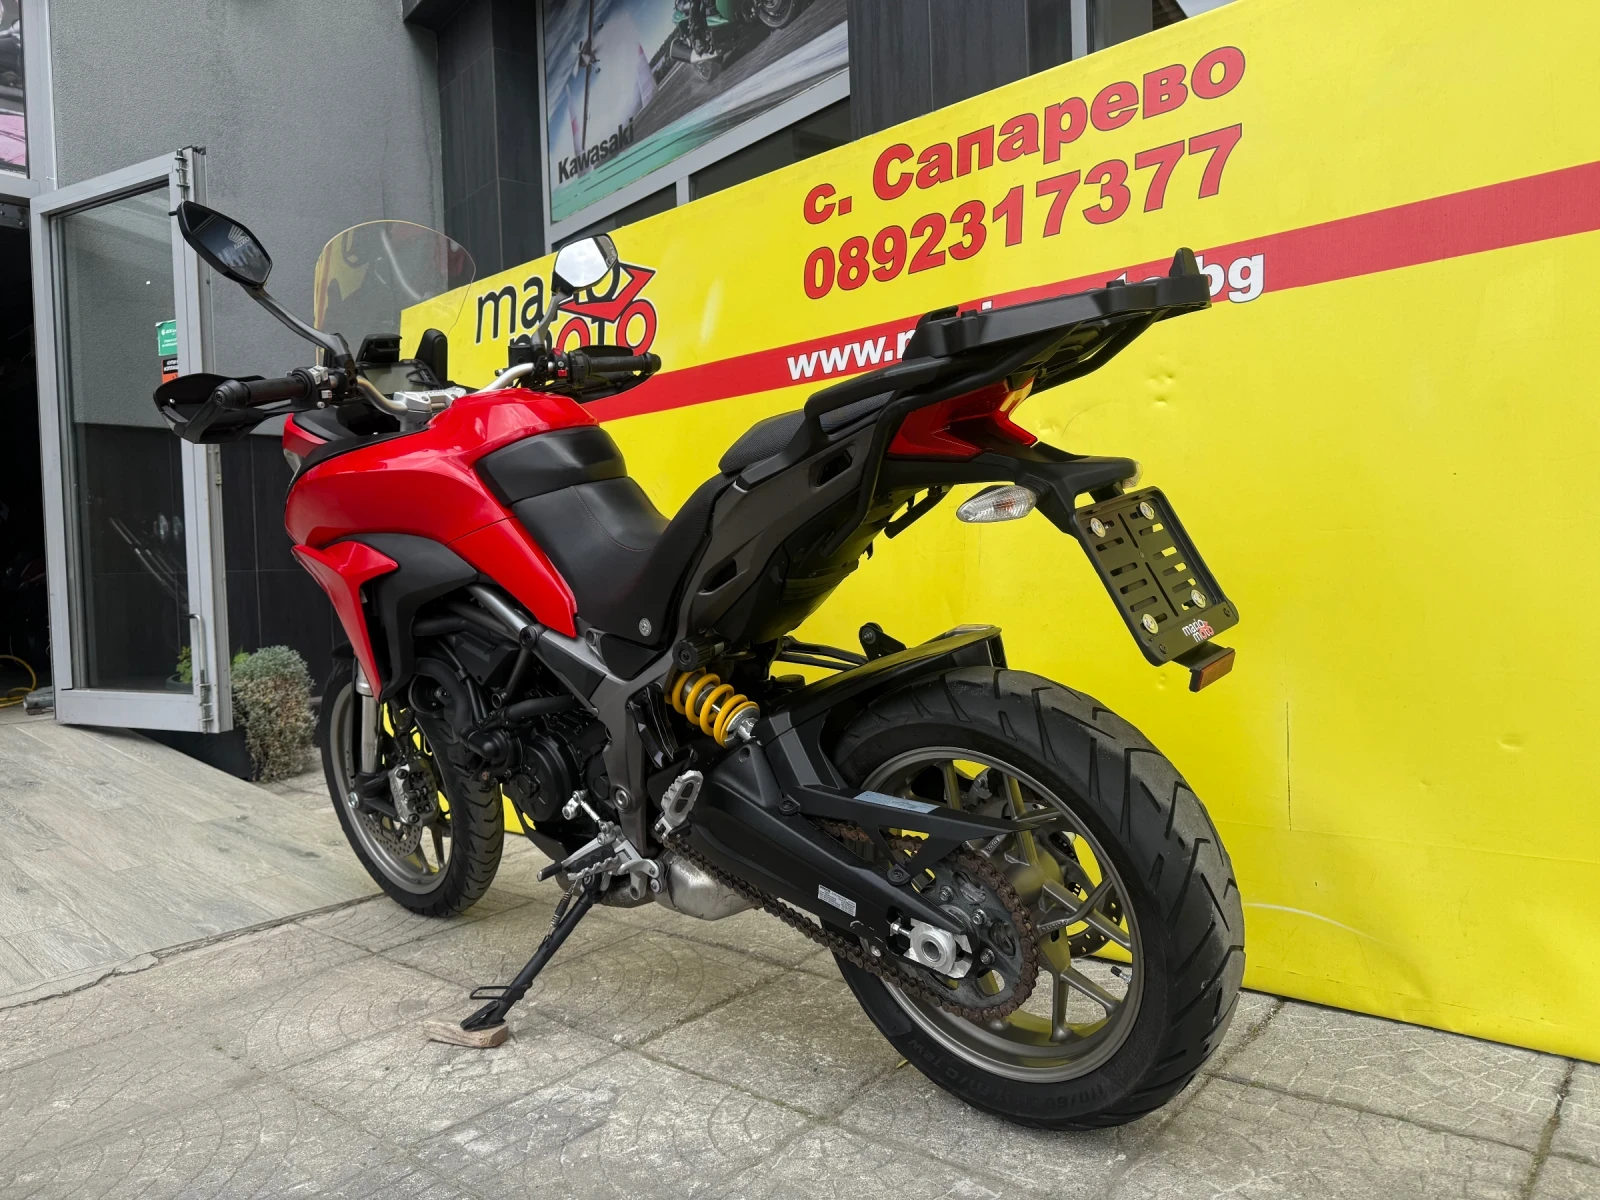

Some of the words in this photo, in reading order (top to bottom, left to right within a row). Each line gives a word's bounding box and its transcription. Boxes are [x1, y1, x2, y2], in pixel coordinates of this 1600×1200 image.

[558, 117, 633, 184] Kawasaki
[804, 183, 852, 224] с.
[873, 46, 1245, 201] Сапарево
[804, 123, 1242, 299] 0892317377
[1182, 619, 1205, 636] mario
